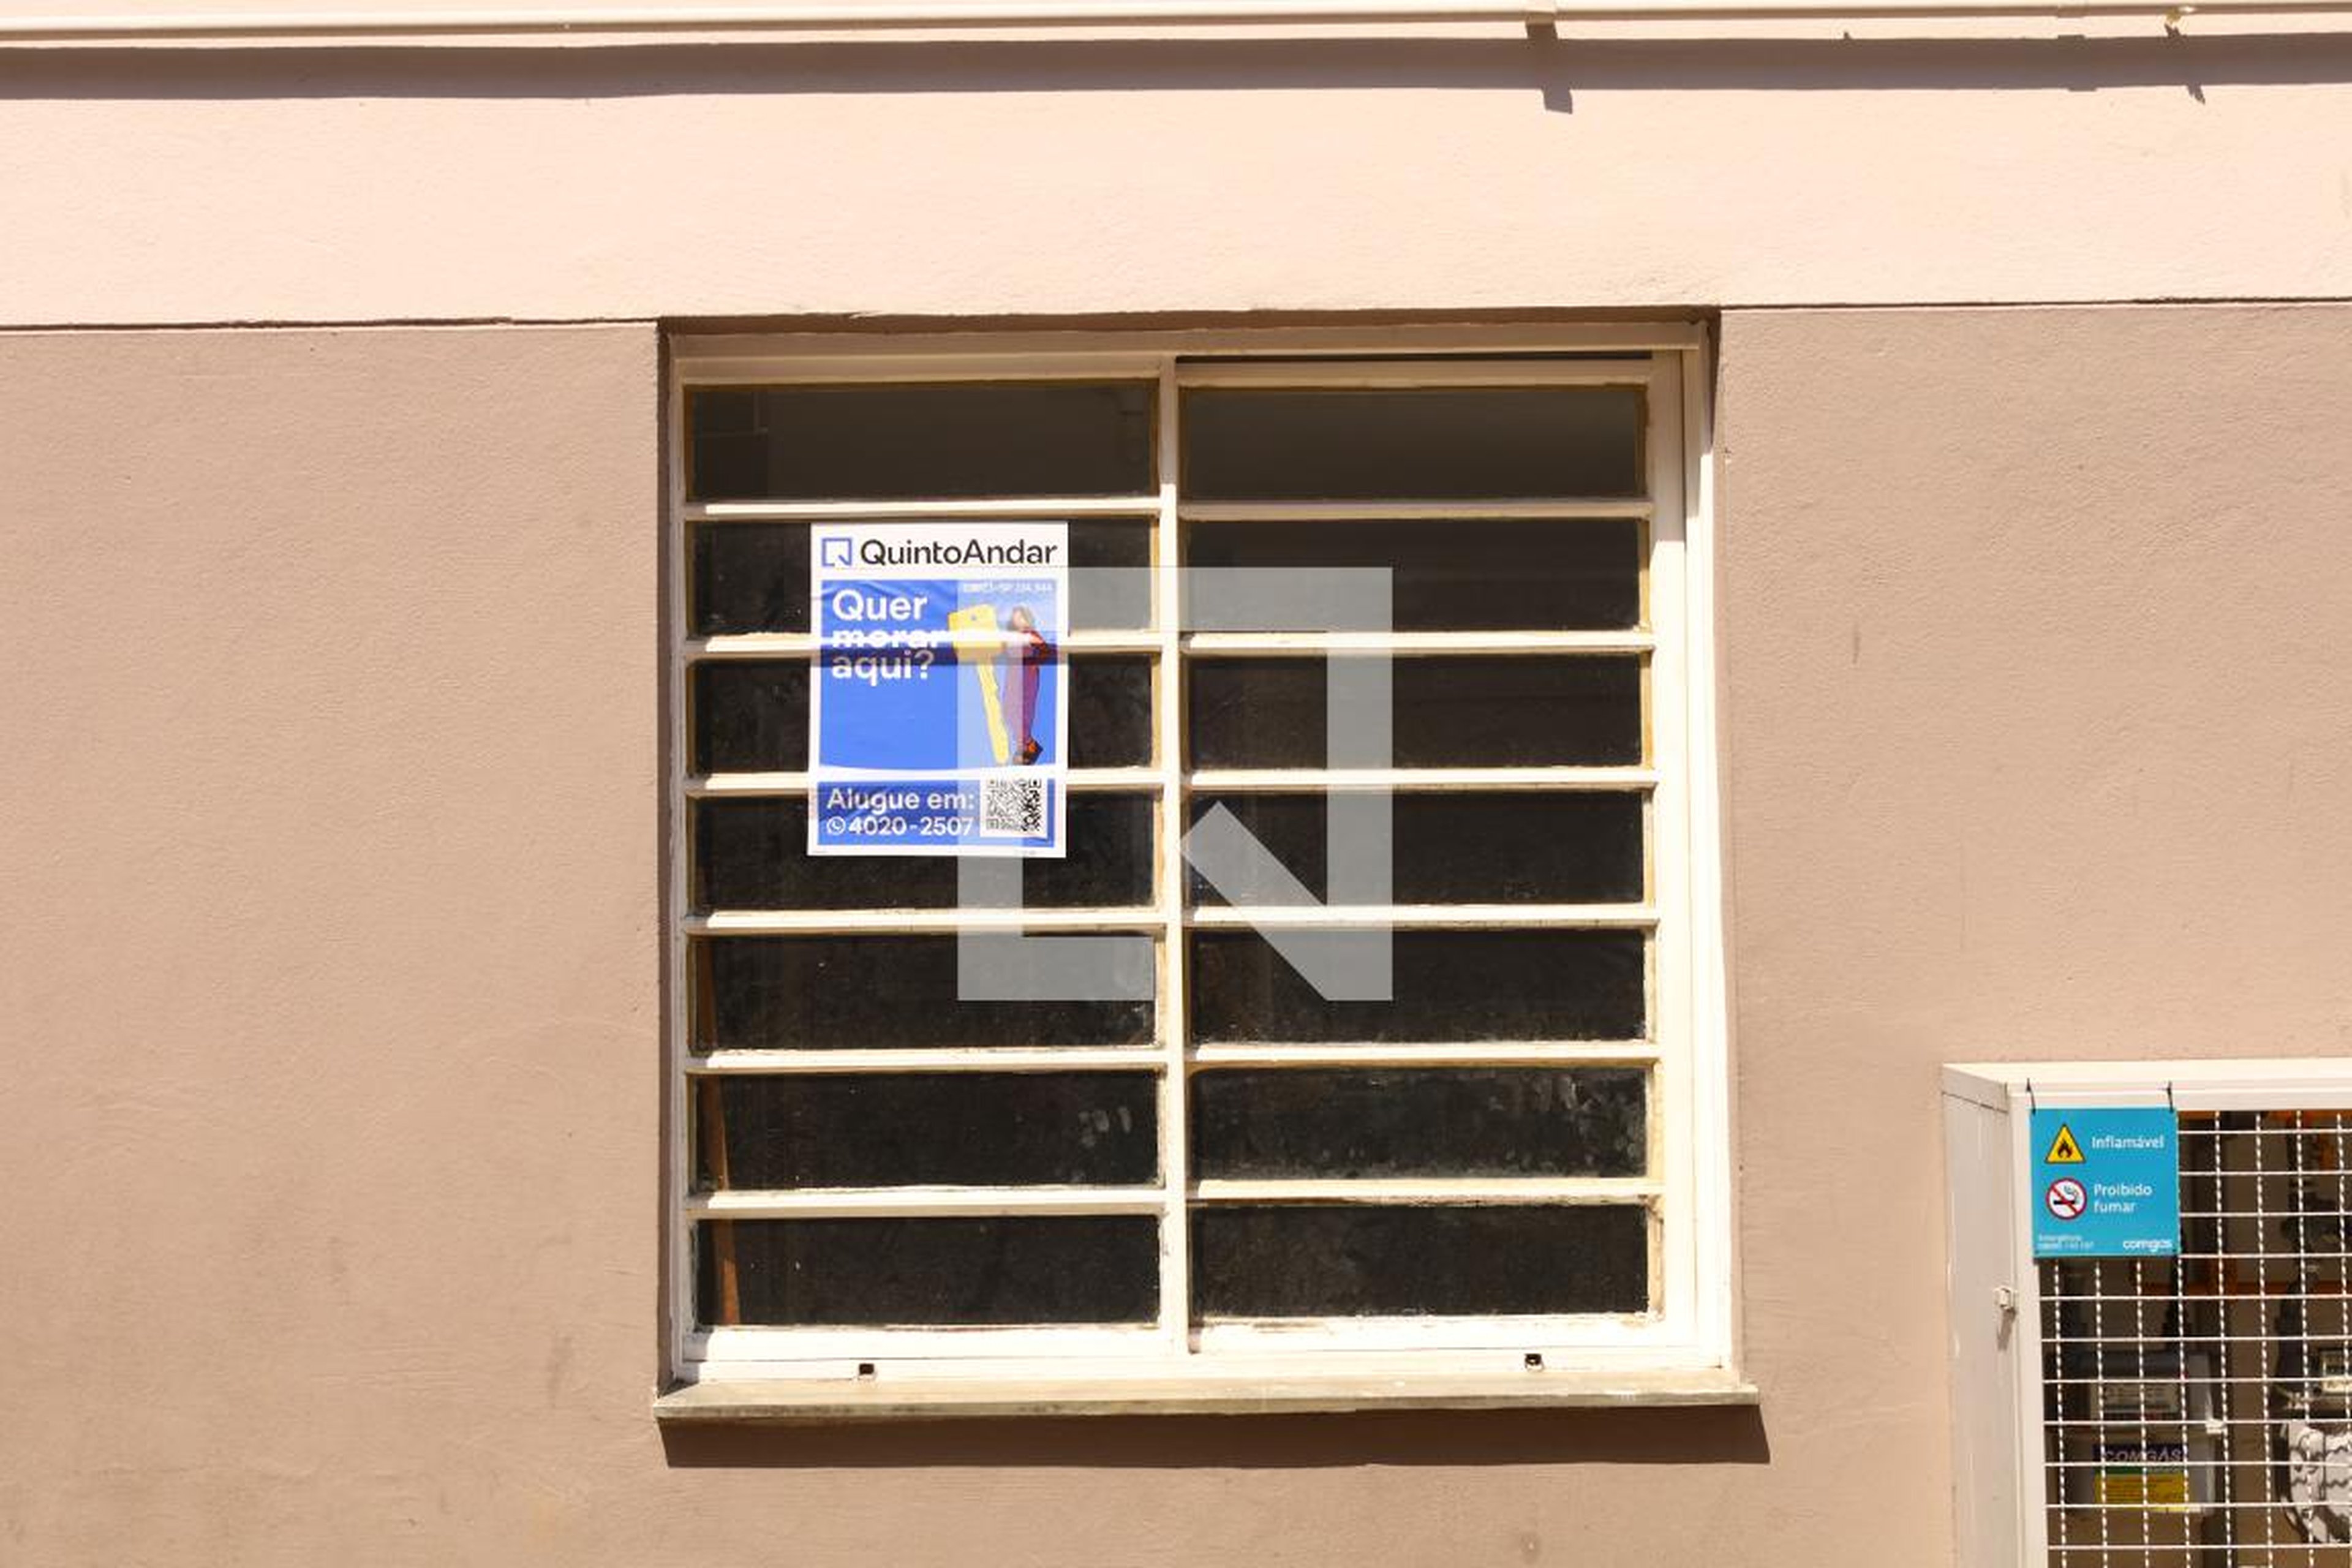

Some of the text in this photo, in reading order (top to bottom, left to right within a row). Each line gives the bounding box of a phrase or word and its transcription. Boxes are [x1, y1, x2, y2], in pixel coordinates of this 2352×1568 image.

[860, 538, 1058, 565] QuintoAndar
[832, 589, 928, 620] Quer
[832, 649, 935, 687] aqui?
[827, 788, 975, 815] Alugue em:
[848, 816, 974, 836] 4020-2507
[2091, 1135, 2165, 1149] Inflamável
[2094, 1183, 2153, 1197] Proibido
[2094, 1200, 2137, 1213] fumar
